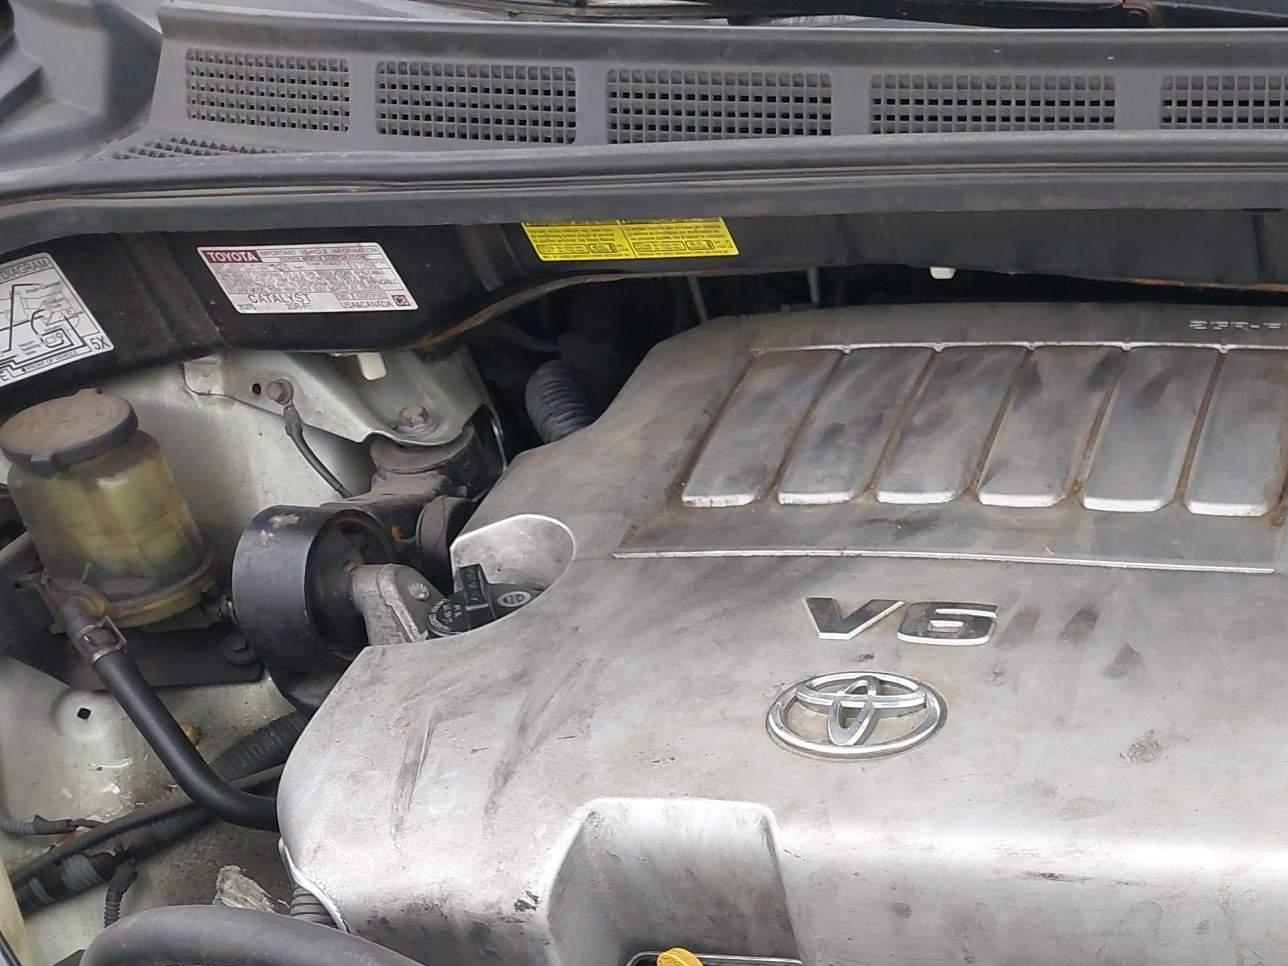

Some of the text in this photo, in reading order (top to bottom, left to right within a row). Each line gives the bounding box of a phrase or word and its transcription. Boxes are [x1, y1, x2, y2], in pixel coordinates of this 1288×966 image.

[206, 251, 259, 262] TOYOTA
[0, 259, 49, 279] DIAGRAM
[247, 293, 312, 304] CATALYST
[89, 336, 110, 350] 5X
[803, 597, 999, 646] V6
